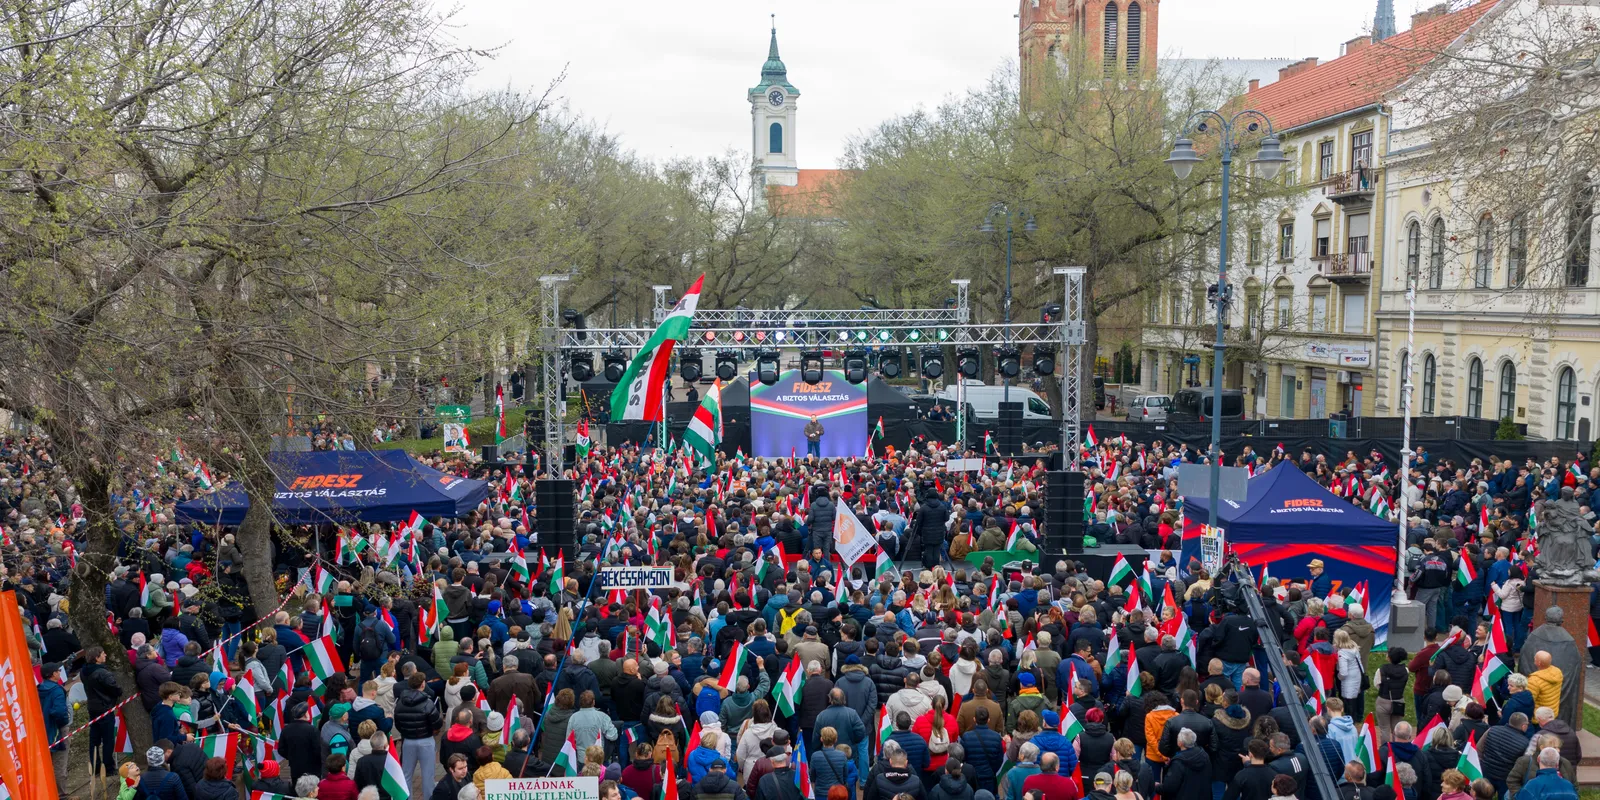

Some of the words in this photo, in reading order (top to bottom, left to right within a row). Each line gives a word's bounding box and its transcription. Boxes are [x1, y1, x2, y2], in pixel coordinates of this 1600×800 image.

[792, 382, 832, 393] FIDESZ
[809, 393, 849, 402] VÁLASZTÁS
[290, 474, 363, 490] FIDESZ
[314, 488, 387, 498] VÁLASZTÁS
[1284, 498, 1323, 508] FIDESZ
[601, 568, 670, 587] BÉKÉSSÁMSON
[508, 779, 575, 790] HAZÁDNAK
